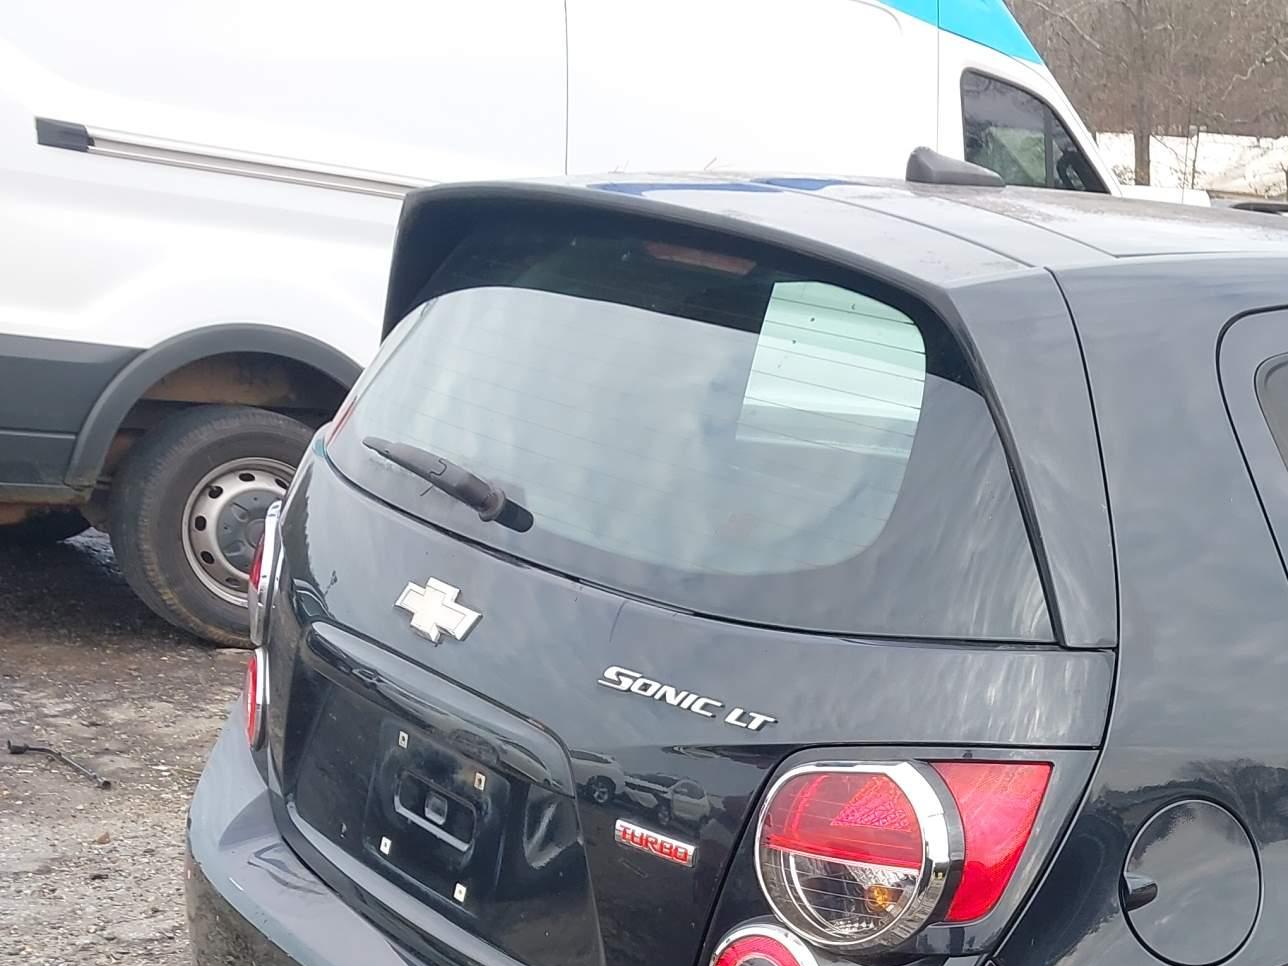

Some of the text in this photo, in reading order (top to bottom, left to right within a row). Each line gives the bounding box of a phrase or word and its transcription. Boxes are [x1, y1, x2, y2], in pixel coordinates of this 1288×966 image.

[597, 664, 778, 730] SONIC LT
[619, 823, 689, 864] TURBO
